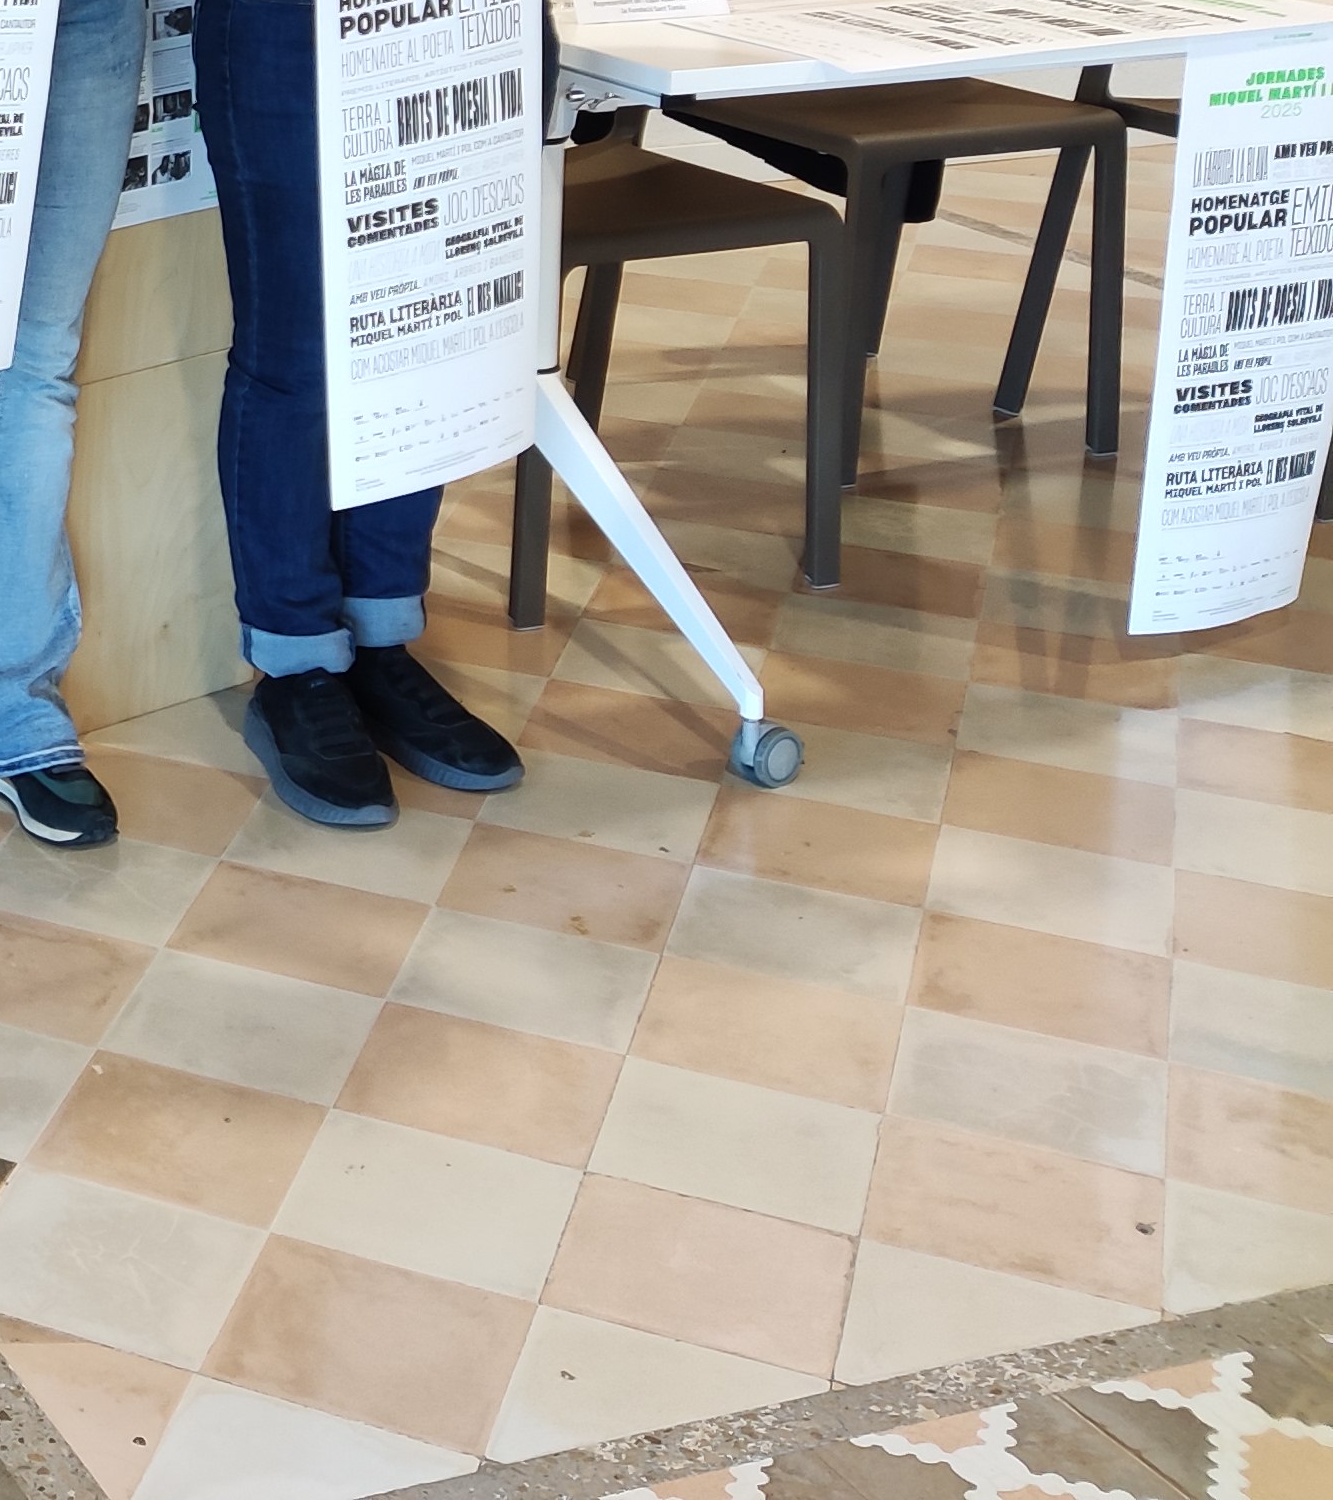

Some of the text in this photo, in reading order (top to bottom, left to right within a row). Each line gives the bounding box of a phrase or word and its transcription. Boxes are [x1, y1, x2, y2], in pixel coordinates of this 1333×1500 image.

[460, 3, 521, 51] TEIXIDOR
[1246, 66, 1325, 86] JORNADES
[1209, 80, 1325, 107] MIQUEL MARTÍ I
[1261, 103, 1302, 119] 2025
[1191, 189, 1290, 214] HOMENATGE
[347, 197, 439, 233] VISITES
[1189, 208, 1287, 236] POPULAR
[347, 216, 439, 249] COMENTADES
[349, 289, 462, 334] RUTA LITERÀRIA
[1176, 378, 1253, 402] VISITES
[1173, 396, 1251, 414] COMENTADES
[1166, 460, 1263, 486] RUTA LITERÀRIA
